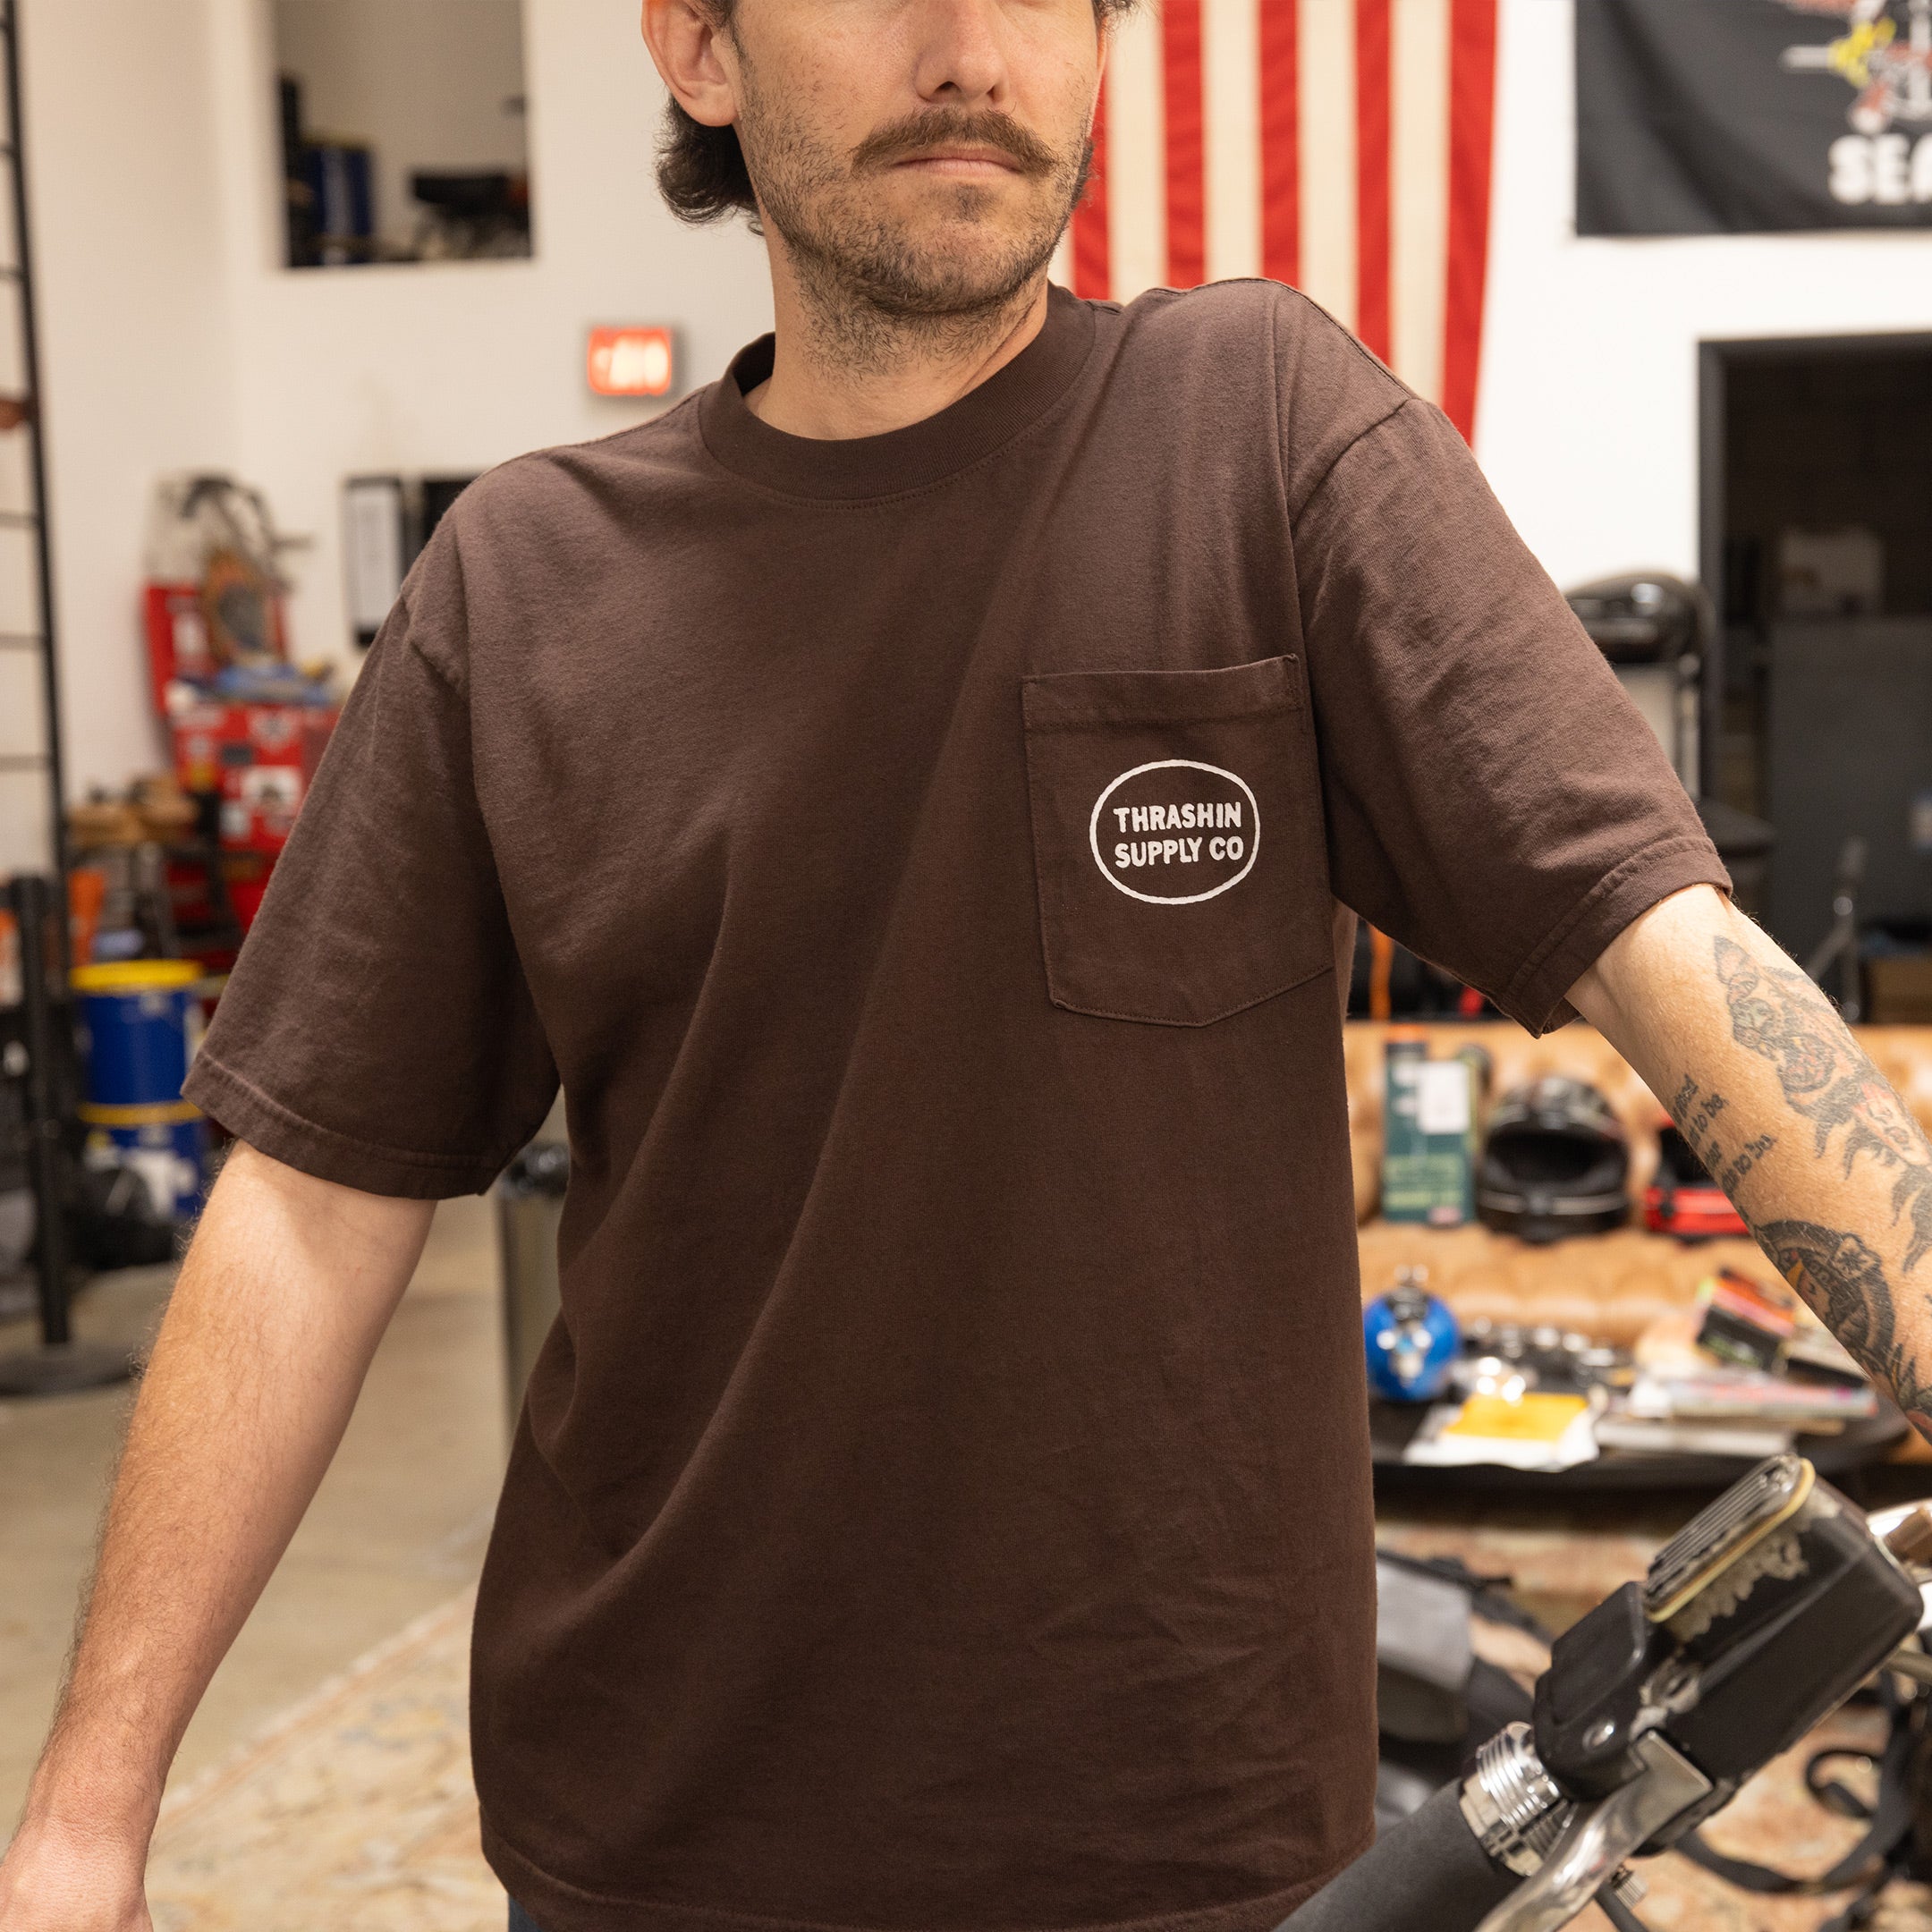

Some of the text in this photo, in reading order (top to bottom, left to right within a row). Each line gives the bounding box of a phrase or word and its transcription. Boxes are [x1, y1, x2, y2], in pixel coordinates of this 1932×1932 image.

[1113, 801, 1241, 833] THRASHIN
[1114, 835, 1244, 868] SUPPLY CO
